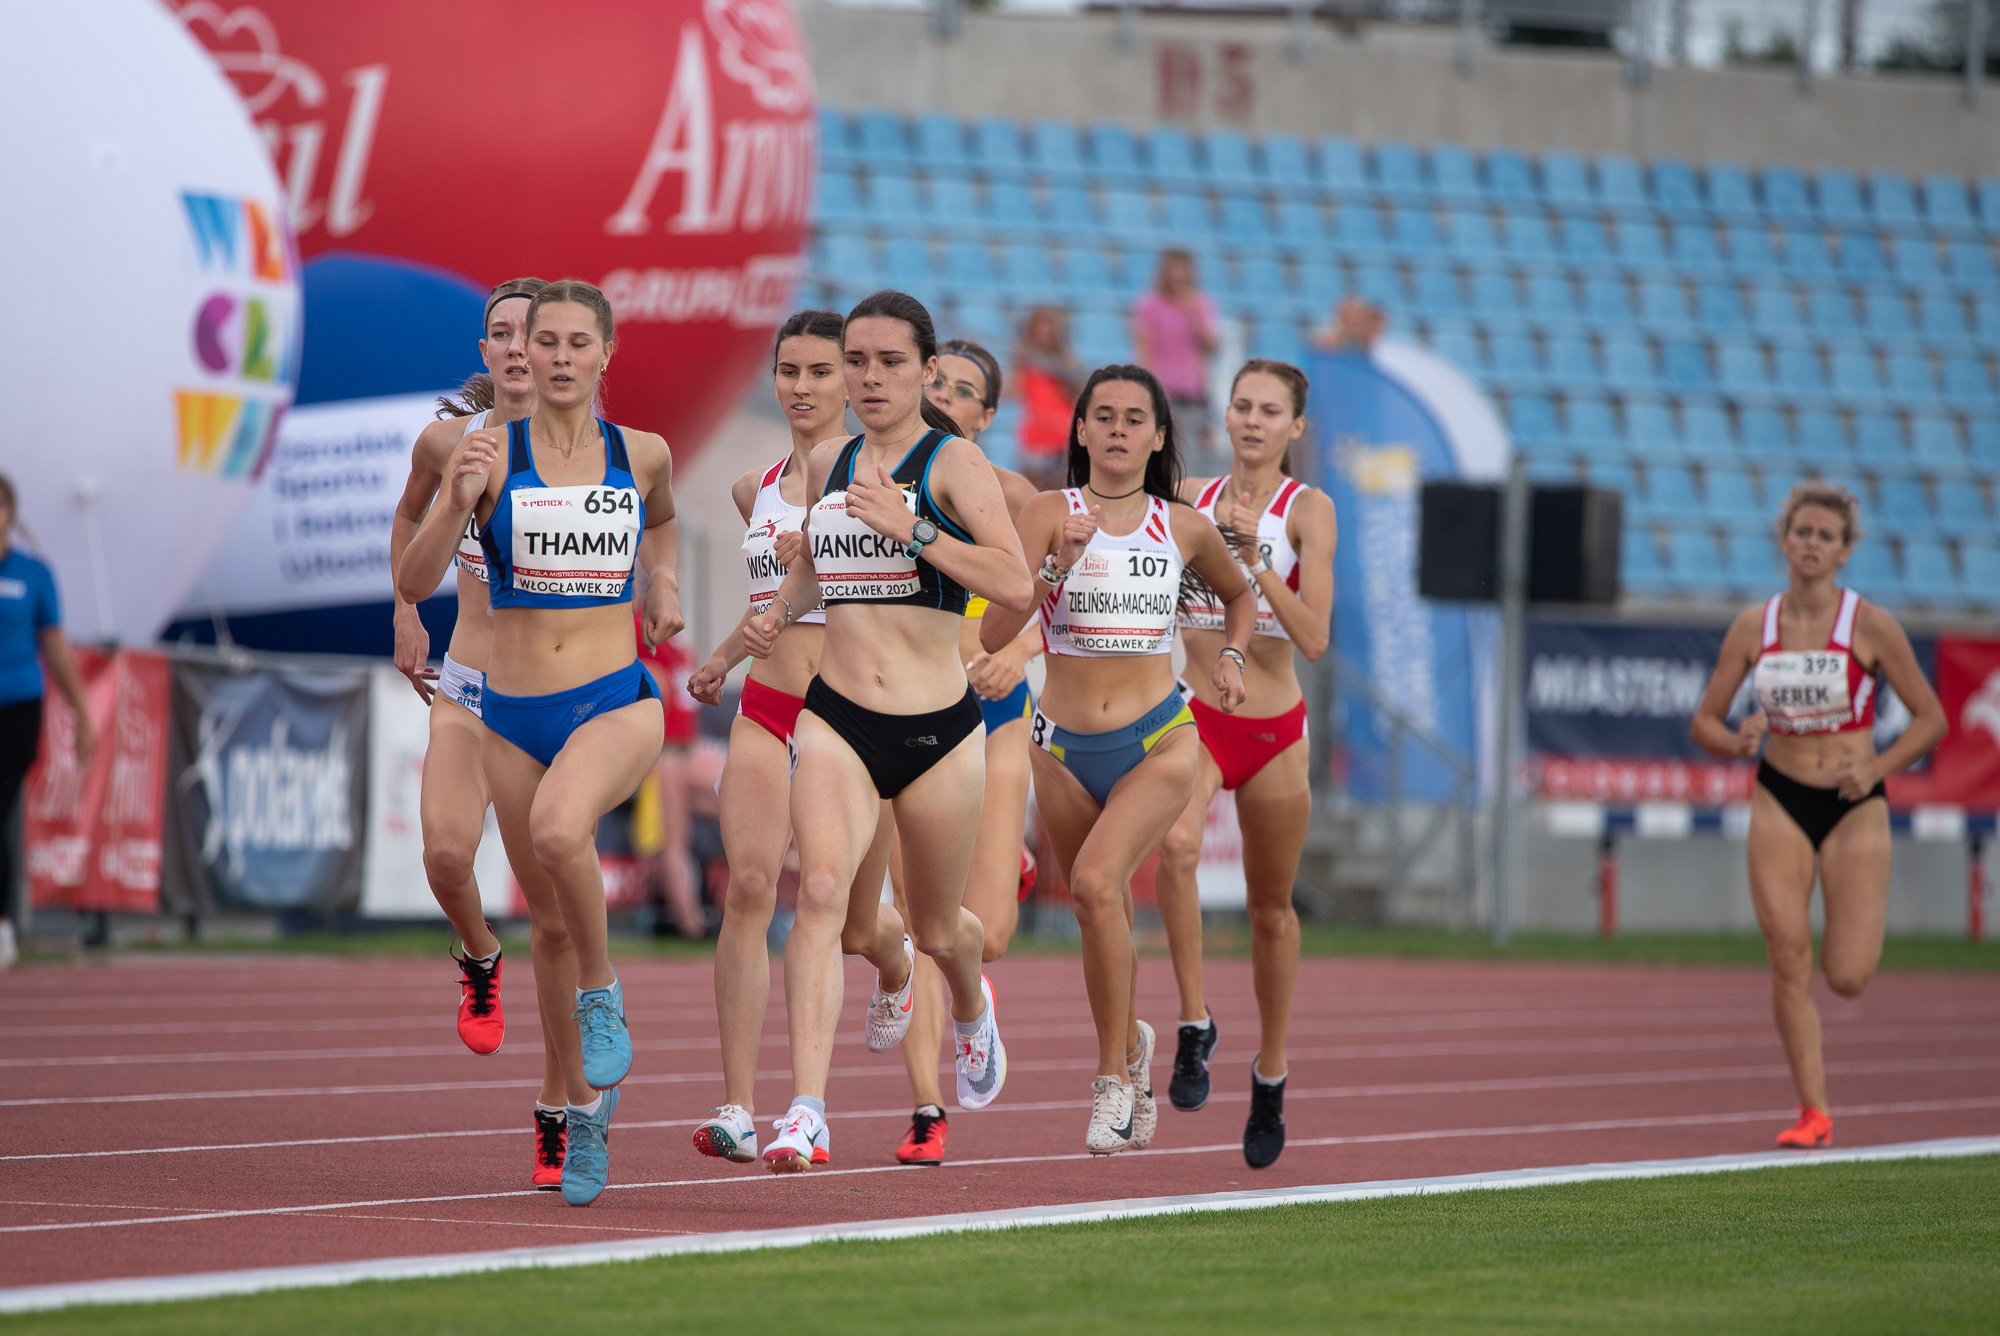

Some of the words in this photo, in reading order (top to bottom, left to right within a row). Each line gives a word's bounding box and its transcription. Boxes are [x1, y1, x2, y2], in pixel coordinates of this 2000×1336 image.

[584, 490, 634, 514] 654
[523, 532, 629, 556] THAMM
[813, 534, 905, 559] JANICKA
[1079, 556, 1109, 571] Anwil
[1128, 555, 1168, 578] 107
[519, 578, 602, 594] WŁOCŁAWEK
[820, 584, 884, 597] ŁOCŁAWEK
[885, 582, 914, 595] 2021
[1068, 587, 1172, 616] ZIELIŃSKA-MACHADO
[1073, 636, 1144, 649] WŁOCŁAWEK
[1770, 684, 1832, 706] SEREK
[1032, 713, 1047, 747] 8
[1135, 707, 1168, 737] NIKE
